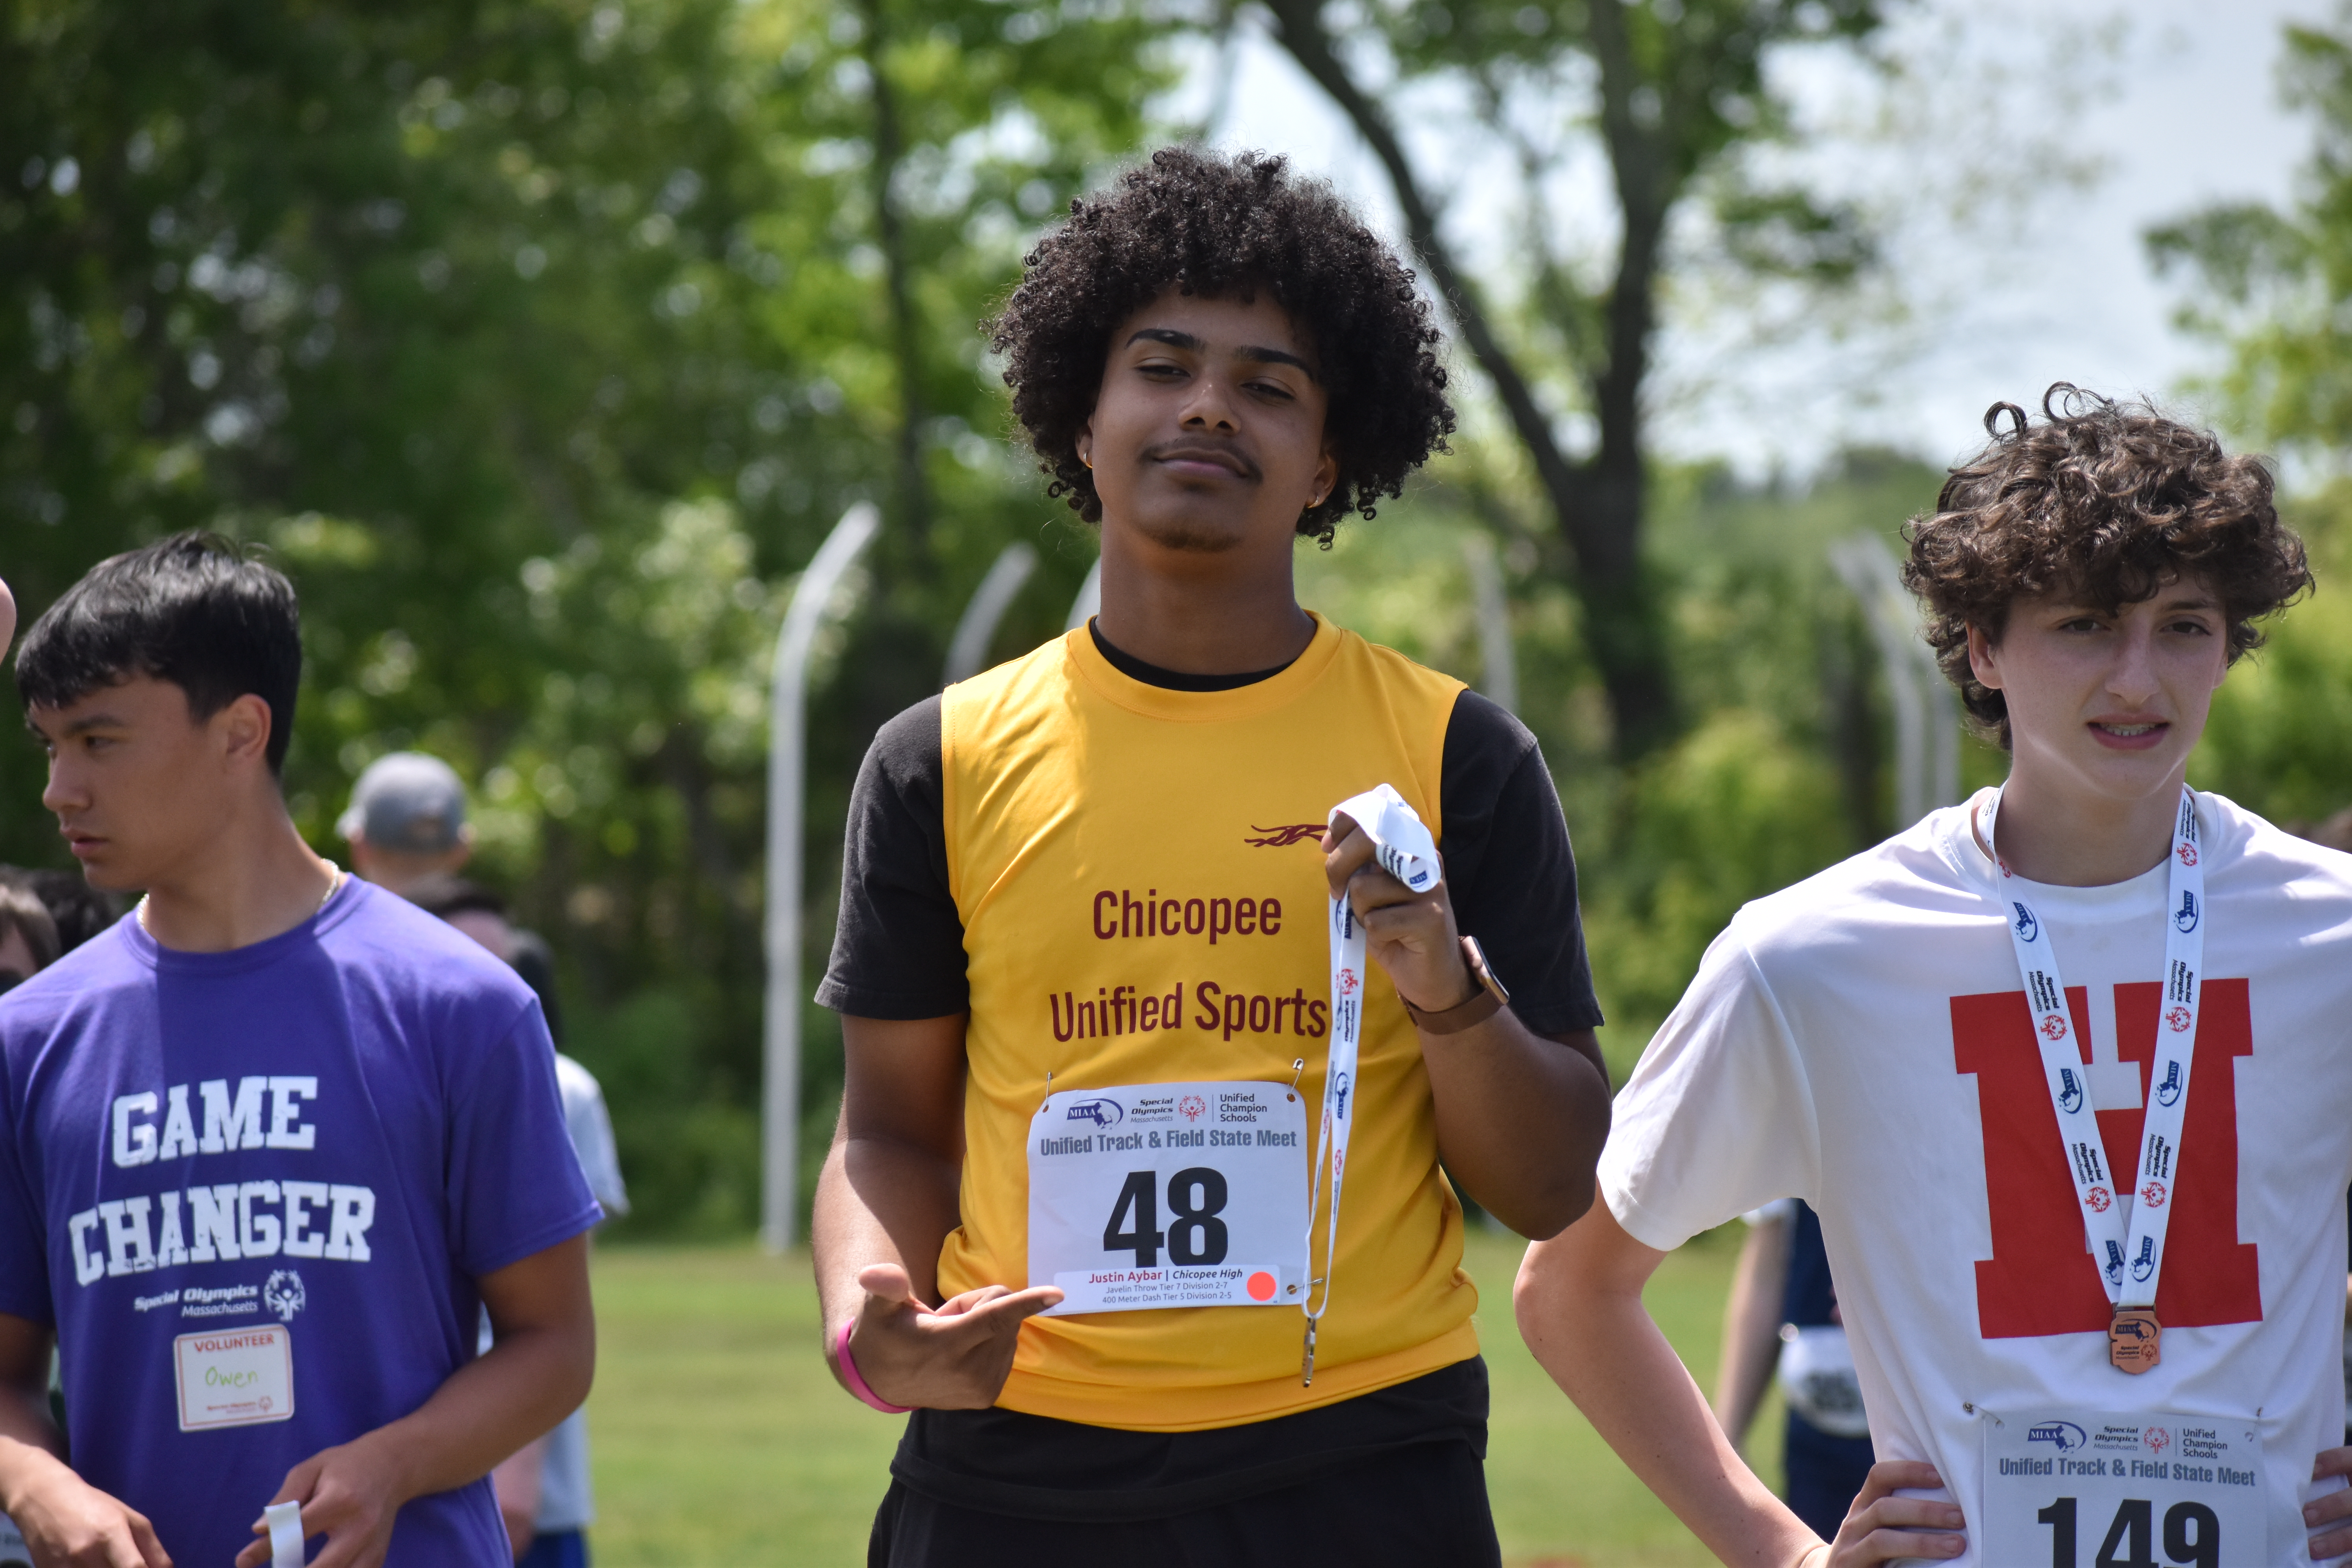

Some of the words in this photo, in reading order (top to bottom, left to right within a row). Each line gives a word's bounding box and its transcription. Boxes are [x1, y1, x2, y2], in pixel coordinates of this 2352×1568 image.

[1094, 889, 1281, 945] Chicopee
[2029, 972, 2042, 1012] Massachusetts
[2037, 971, 2051, 1010] Olympics
[2047, 977, 2060, 1008] Special
[2169, 959, 2178, 1000] Massachusetts
[2178, 962, 2186, 1002] Olympics
[1050, 982, 1182, 1042] Unified
[1195, 981, 1327, 1042] Sports
[2064, 1071, 2073, 1091] MIAA
[2169, 1063, 2178, 1085] MIAA
[1132, 1107, 1173, 1115] Olympics
[1140, 1098, 1173, 1106] Special
[1220, 1093, 1254, 1102] Unified
[1220, 1103, 1267, 1113] Champion
[113, 1076, 318, 1169] GAME
[1069, 1109, 1096, 1118] MIAA
[1220, 1113, 1257, 1122] Schools
[1041, 1136, 1092, 1156] Unified
[1097, 1132, 1143, 1151] Track
[1149, 1131, 1161, 1149] &
[1167, 1129, 1204, 1147] Field
[1210, 1130, 1252, 1146] State
[1257, 1130, 1296, 1147] Meet
[2145, 1134, 2156, 1176] Massachusetts
[2153, 1136, 2164, 1177] Olympics
[1950, 978, 2263, 1339] H
[2072, 1143, 2087, 1184] Massachusetts
[2080, 1143, 2094, 1183] Olympics
[2090, 1149, 2103, 1180] Special
[2161, 1146, 2171, 1179] Special
[1103, 1167, 1228, 1268] 48
[68, 1180, 376, 1287] CHANGER
[1089, 1272, 1124, 1283] Justin
[1128, 1270, 1162, 1283] Aybar
[1173, 1270, 1217, 1280] Chicopee
[1220, 1269, 1242, 1279] High
[1106, 1285, 1131, 1294] Javelin
[134, 1289, 180, 1312] Special
[183, 1284, 259, 1303] Olympics
[181, 1300, 259, 1318] Massachusetts
[195, 1334, 274, 1352] VOLUNTEER
[205, 1366, 259, 1388] Owen
[2031, 1430, 2058, 1439] MIAA
[2183, 1428, 2216, 1439] Unified
[2183, 1439, 2228, 1450] Champion
[2183, 1449, 2218, 1459] Schools
[2000, 1458, 2053, 1475] Unified
[2058, 1458, 2107, 1475] Track
[2112, 1459, 2126, 1476] &
[2131, 1459, 2168, 1479] Field
[2173, 1463, 2213, 1483] State
[2218, 1467, 2256, 1486] Meet
[2038, 1497, 2220, 1568] 149
